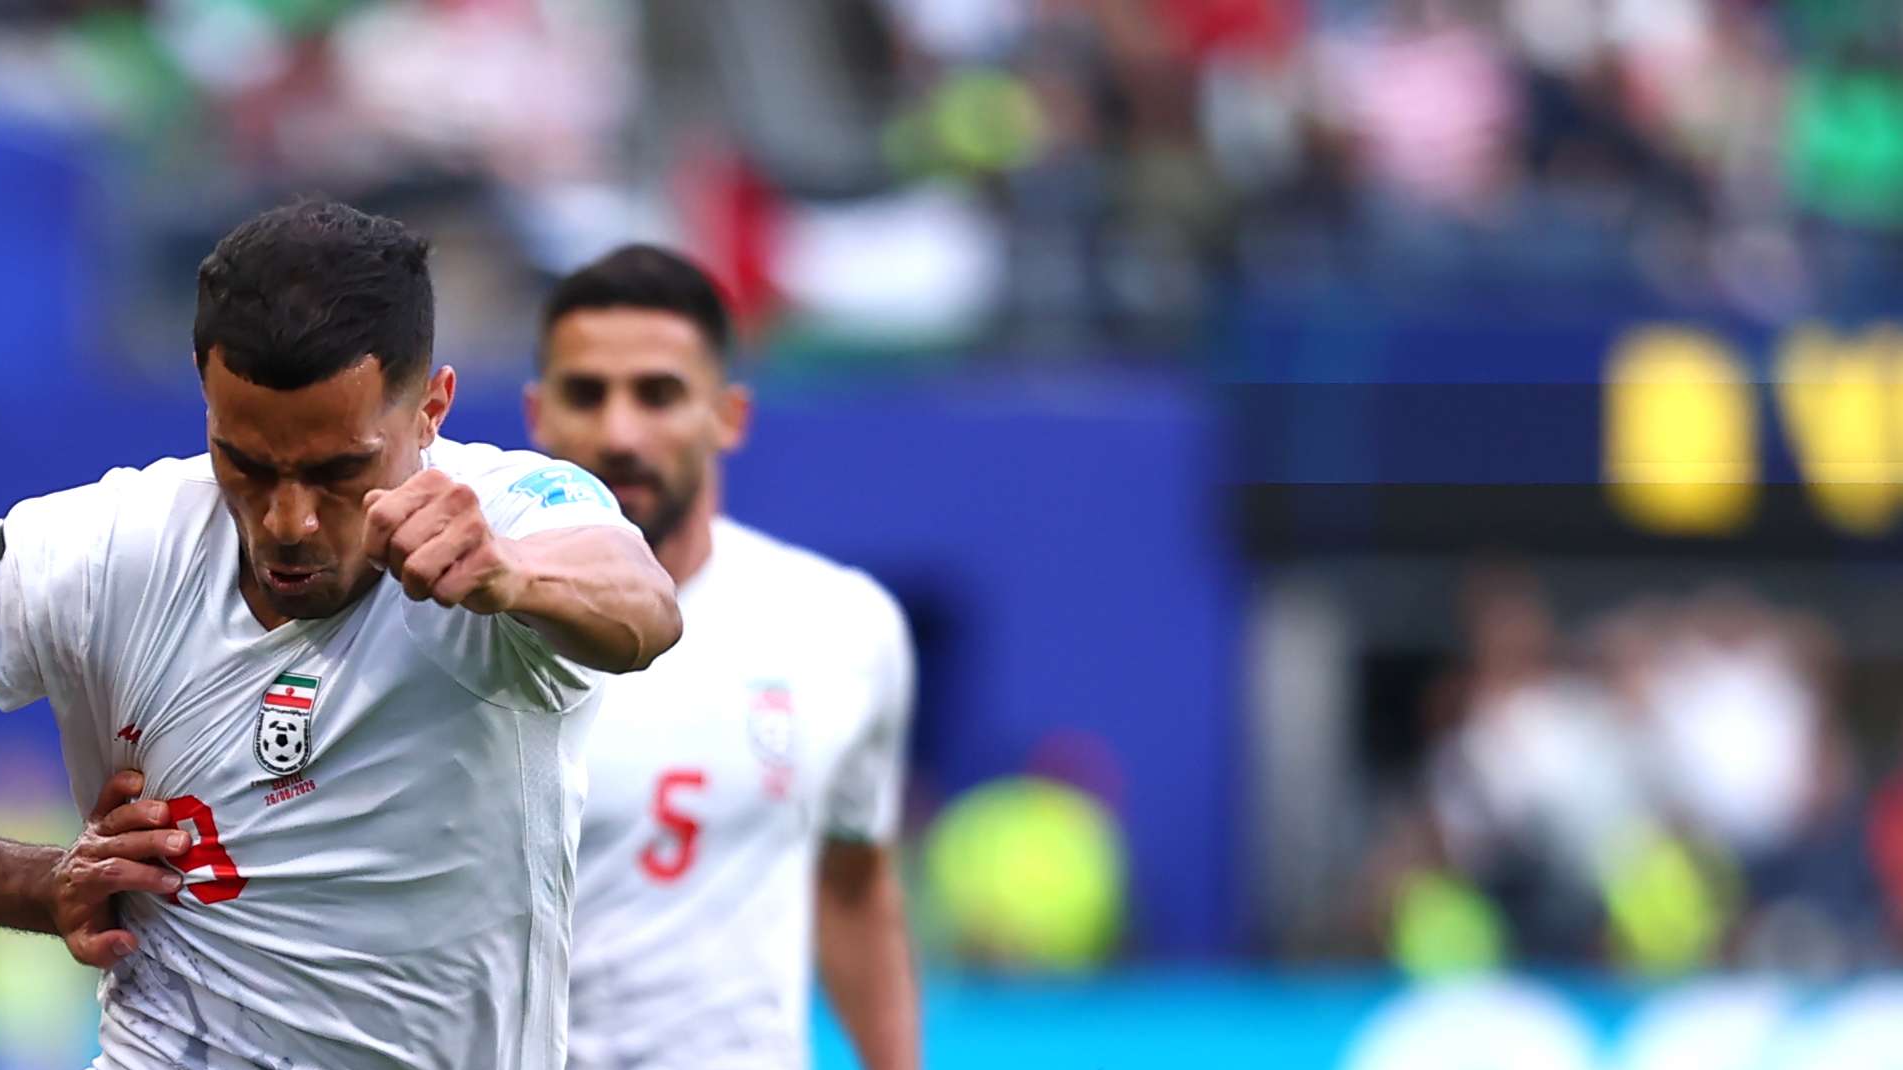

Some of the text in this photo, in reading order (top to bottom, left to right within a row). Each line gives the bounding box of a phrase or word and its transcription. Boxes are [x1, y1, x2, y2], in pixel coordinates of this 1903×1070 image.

[264, 779, 316, 806] 26/06/2026
[638, 767, 705, 884] 5
[164, 795, 249, 906] 9
